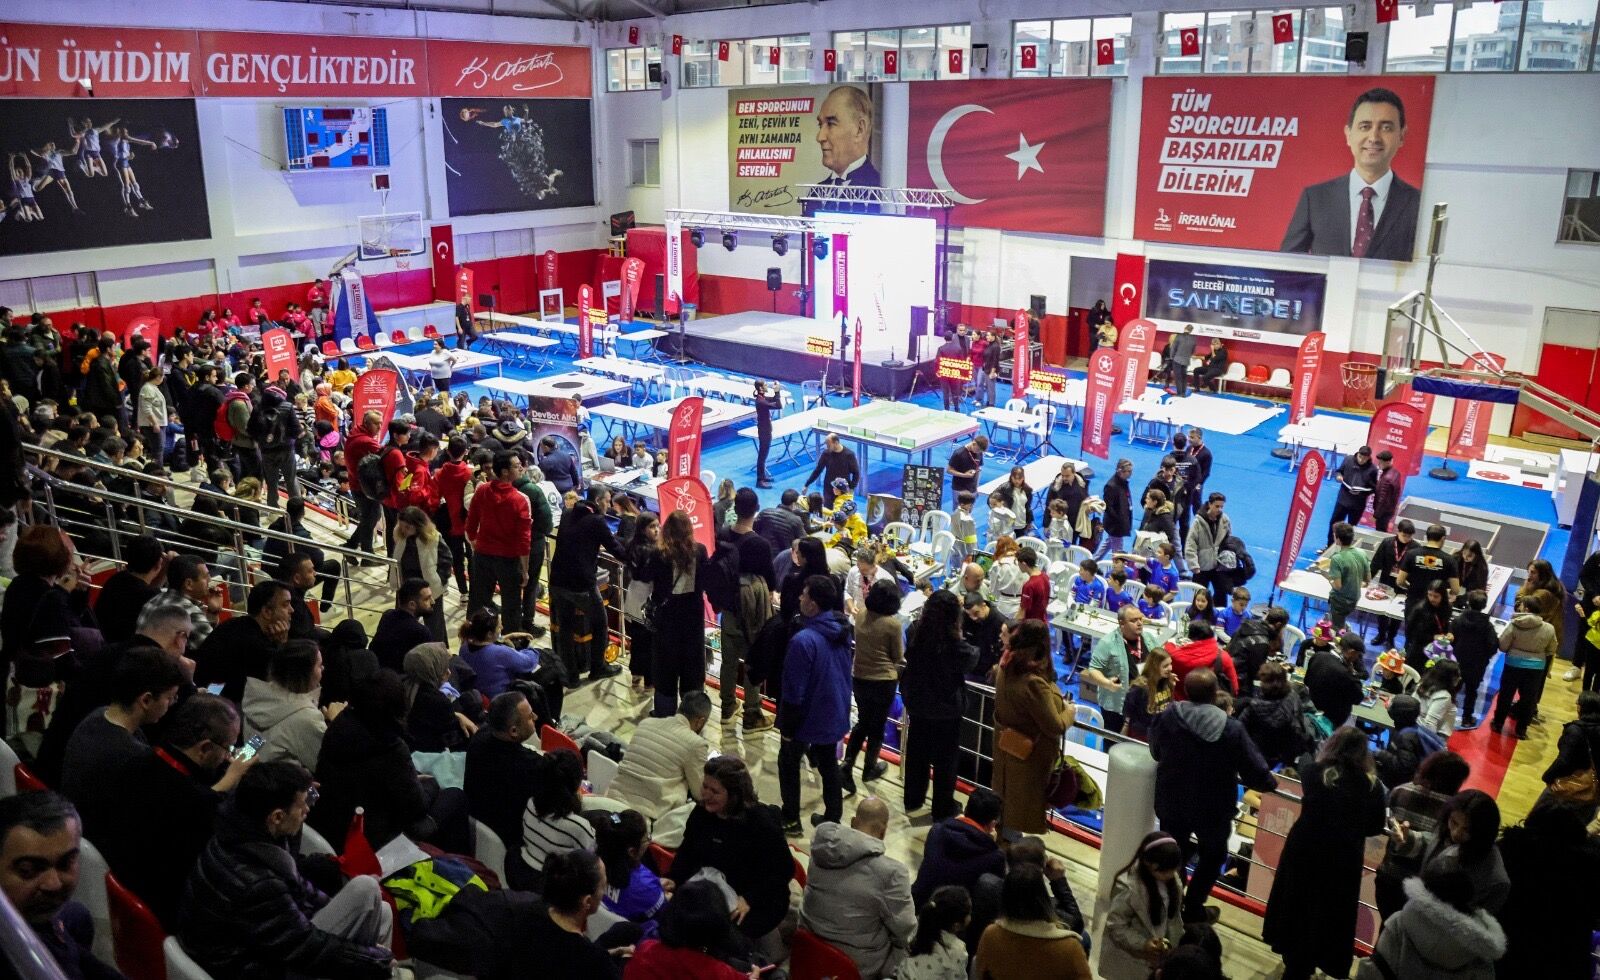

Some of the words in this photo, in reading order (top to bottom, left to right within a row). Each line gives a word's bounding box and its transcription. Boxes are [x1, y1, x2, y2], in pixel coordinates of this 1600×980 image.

[57, 39, 191, 83] ÜMİDİM
[206, 47, 416, 92] GENÇLİKTEDİR
[738, 102, 756, 114] BEN
[756, 99, 811, 113] SPORCUNUN
[1170, 88, 1212, 112] TÜM
[738, 115, 760, 130] ZEKİ,
[761, 115, 787, 131] ÇEVİK
[789, 116, 801, 128] VE
[1167, 115, 1299, 136] SPORCULARA
[738, 133, 759, 144] AYNI
[760, 132, 802, 144] ZAMANDA
[738, 148, 793, 160] AHLAKLISINI
[1166, 140, 1277, 163] BAŞARILAR
[739, 162, 779, 177] SEVERİM.
[1163, 167, 1248, 195] DİLERİM.
[1178, 211, 1208, 227] İRFAN
[1208, 214, 1237, 228] ÖNAL
[1192, 280, 1225, 292] GELECEĞİ
[1225, 284, 1275, 297] KODLAYANLAR
